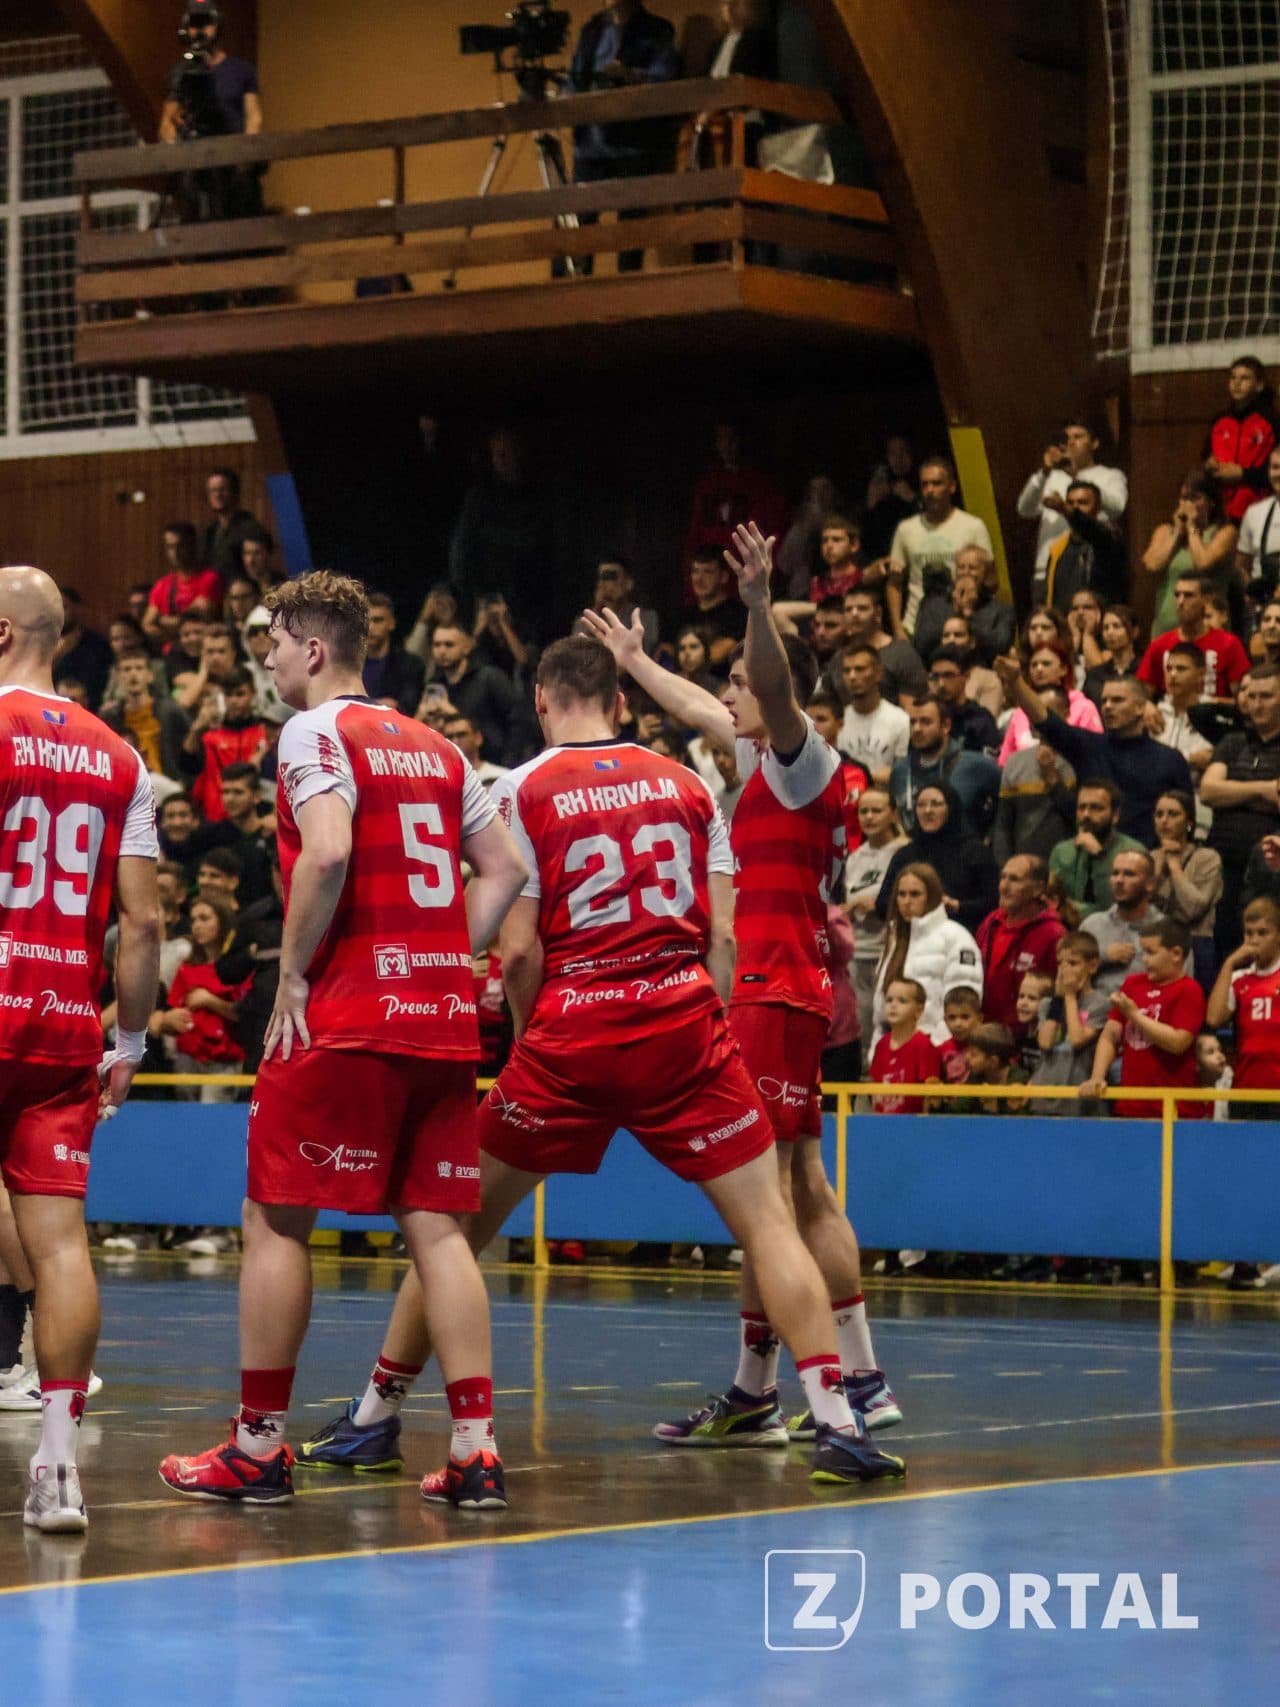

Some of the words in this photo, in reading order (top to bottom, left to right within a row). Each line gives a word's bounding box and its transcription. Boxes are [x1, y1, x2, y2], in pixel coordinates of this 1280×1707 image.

[12, 736, 36, 766] RK
[38, 738, 113, 781] KRIVAJA
[587, 777, 680, 812] KRIVAJA
[398, 803, 455, 909] 5
[564, 822, 696, 931] 23
[12, 942, 62, 963] KRIVAJA
[410, 953, 459, 967] KRIVAJA
[379, 995, 438, 1021] Prevoz
[558, 988, 625, 1014] Prevoz
[1251, 997, 1272, 1020] 21
[707, 1108, 760, 1144] avangarde
[299, 1141, 382, 1173] Amor
[345, 1148, 378, 1159] PIZZERIA
